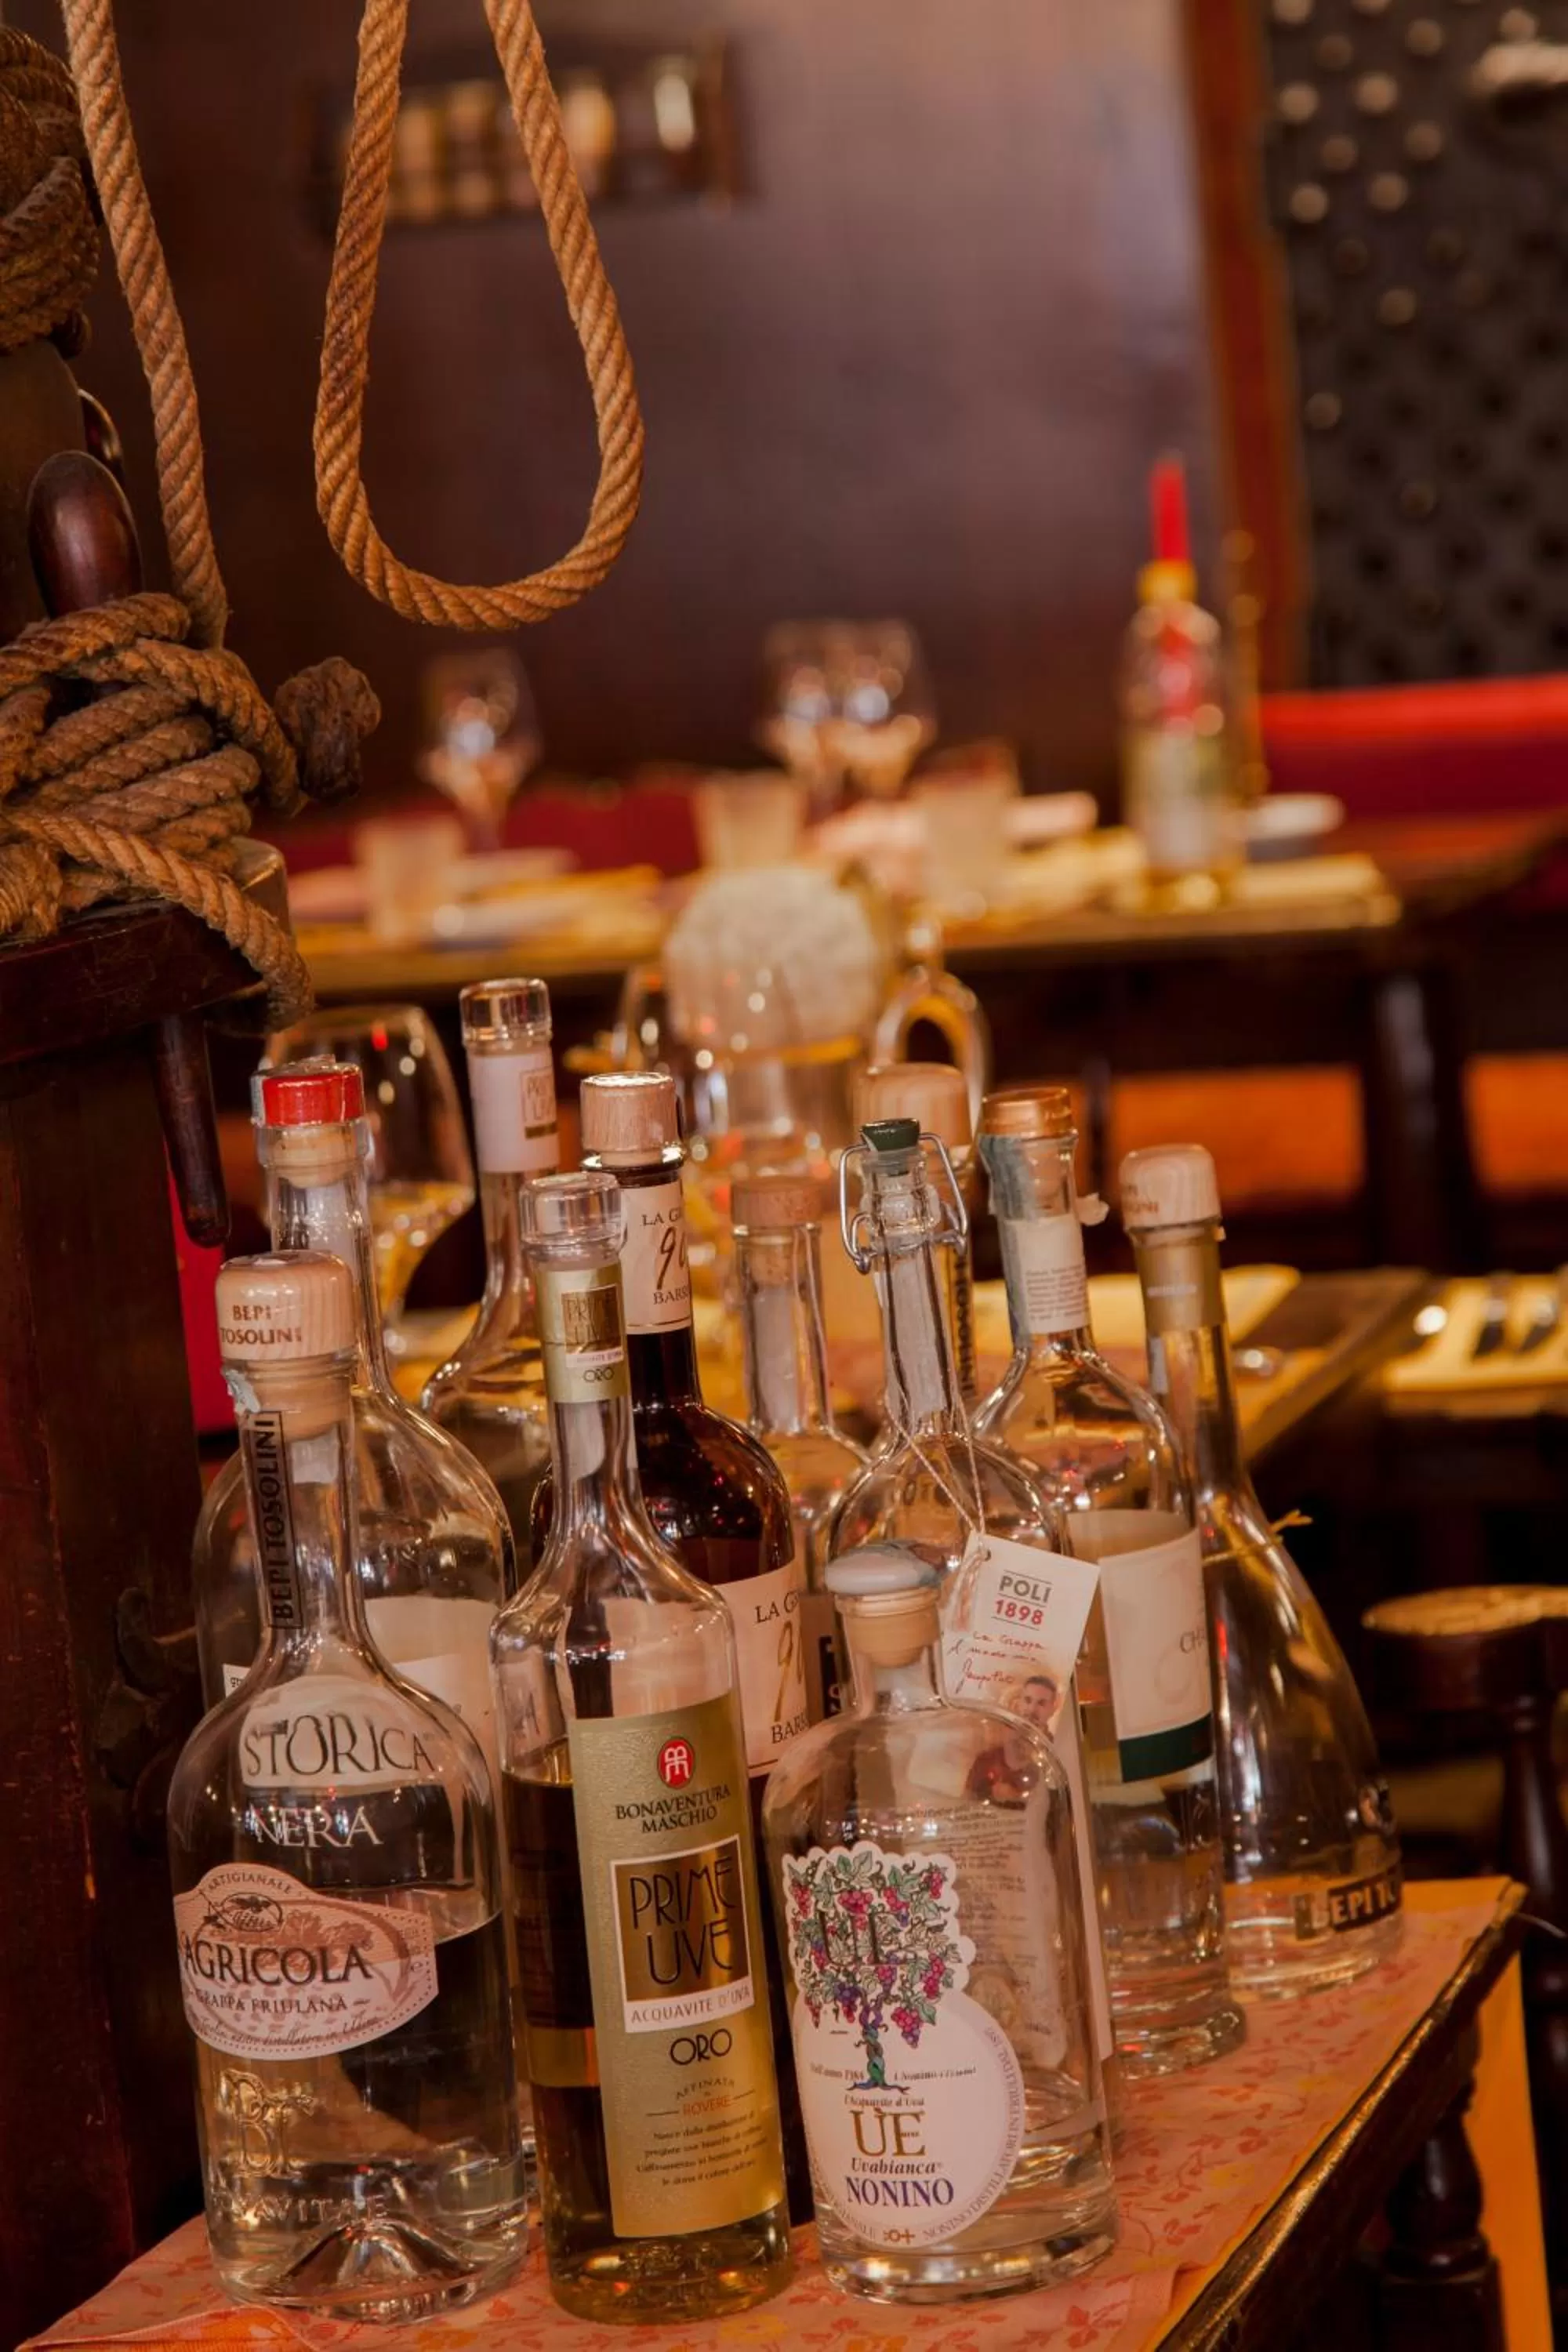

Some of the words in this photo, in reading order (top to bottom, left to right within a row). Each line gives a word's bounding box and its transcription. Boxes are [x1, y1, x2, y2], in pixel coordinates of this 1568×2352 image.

[233, 1305, 271, 1321] BEPI
[220, 1326, 303, 1345] TOSOLINI
[583, 1367, 615, 1383] ORO
[254, 1421, 287, 1548] TOSOLINI
[268, 1560, 293, 1619] BEPI
[999, 1575, 1052, 1603] POLI
[756, 1602, 780, 1624] LA
[995, 1599, 1044, 1625] 1898
[244, 1713, 436, 1777] STORICA
[615, 1784, 731, 1820] BONAVENTURA
[249, 1802, 383, 1848] NERA
[641, 1806, 717, 1834] MASCHIO
[630, 1856, 737, 1929] PRIME
[183, 1936, 372, 1986] AGRICOLA
[647, 1919, 732, 1985] UVE
[251, 1996, 348, 2014] FRIULANA
[631, 1999, 713, 2024] ACQUAVITE
[718, 1985, 750, 2008] D'UVA
[670, 2028, 732, 2066] ORO
[851, 2157, 935, 2175] Uvabianca
[845, 2176, 954, 2209] NONINO
